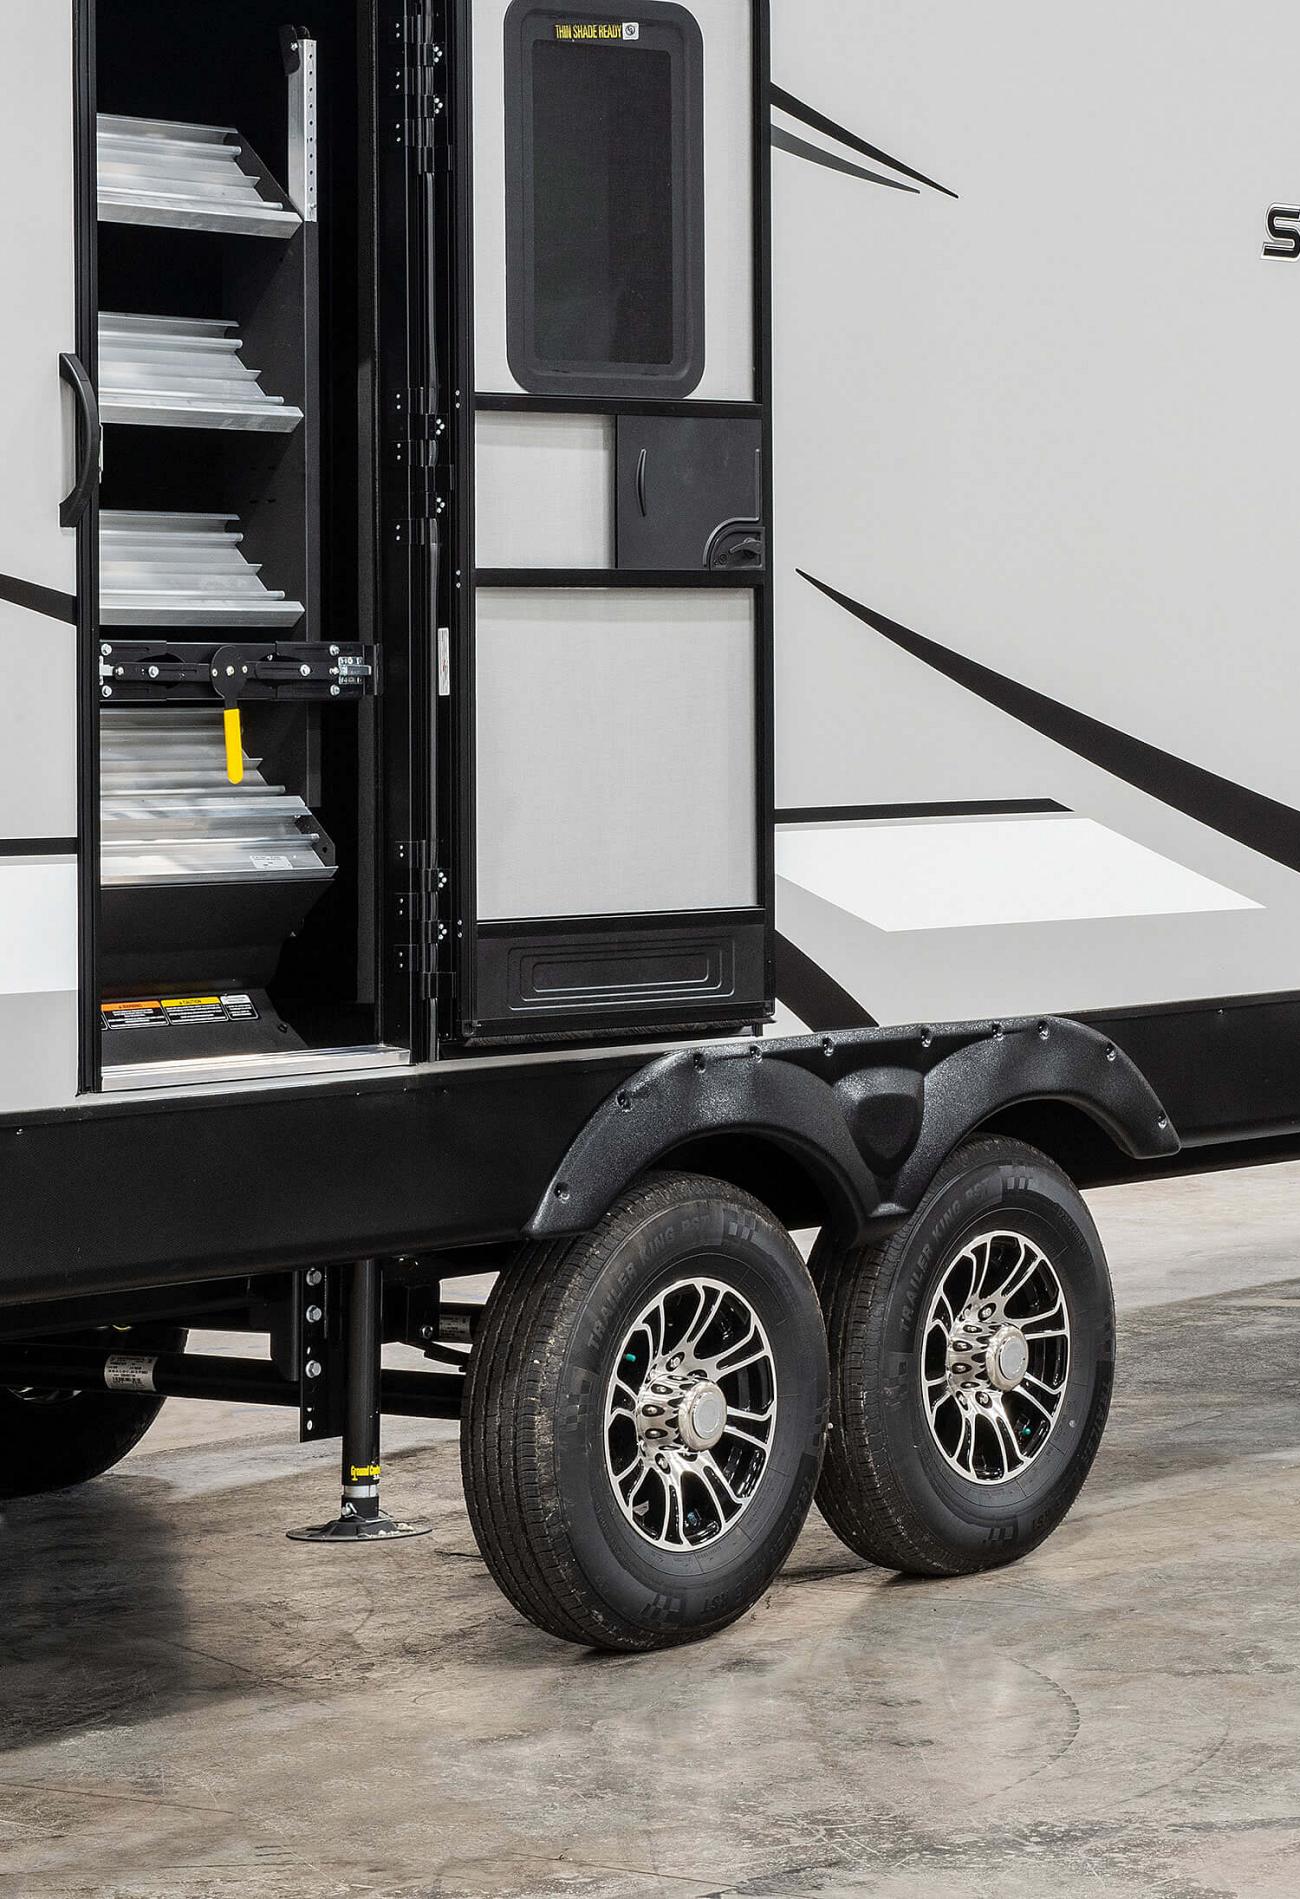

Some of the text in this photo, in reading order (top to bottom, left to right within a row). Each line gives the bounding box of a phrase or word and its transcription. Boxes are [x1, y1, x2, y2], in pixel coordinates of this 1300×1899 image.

[573, 24, 598, 39] SHADE
[598, 24, 622, 39] READY
[932, 1201, 961, 1242] KING
[639, 1225, 675, 1265] KING
